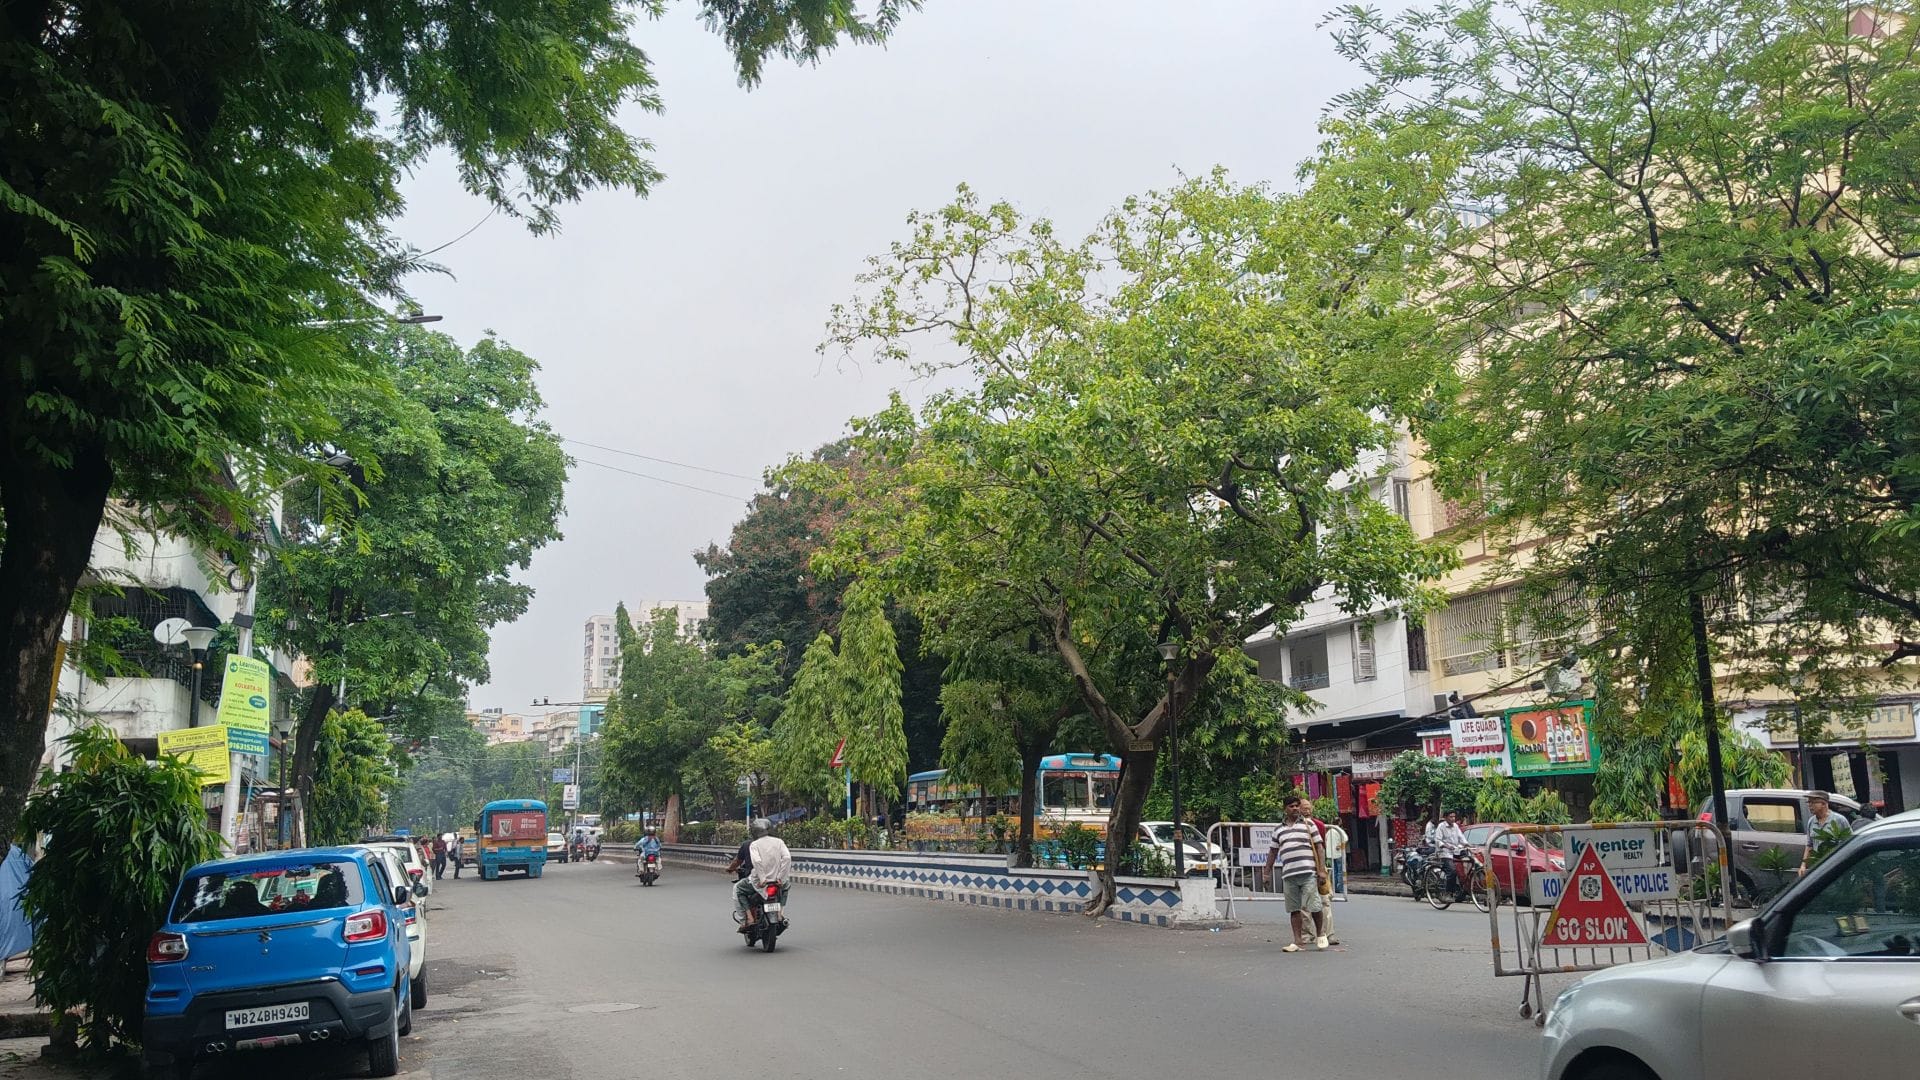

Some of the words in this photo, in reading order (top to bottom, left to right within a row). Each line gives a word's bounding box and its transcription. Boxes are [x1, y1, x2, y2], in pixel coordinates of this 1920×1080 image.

[1460, 721, 1475, 733] LIFE
[1475, 719, 1498, 732] GUARD
[1425, 737, 1454, 757] LIFE
[1623, 851, 1643, 860] REALTY
[1634, 873, 1669, 893] POLICE
[1556, 917, 1581, 941] GO
[1584, 916, 1628, 940] SLOW
[233, 1005, 308, 1026] WB24BH9490
